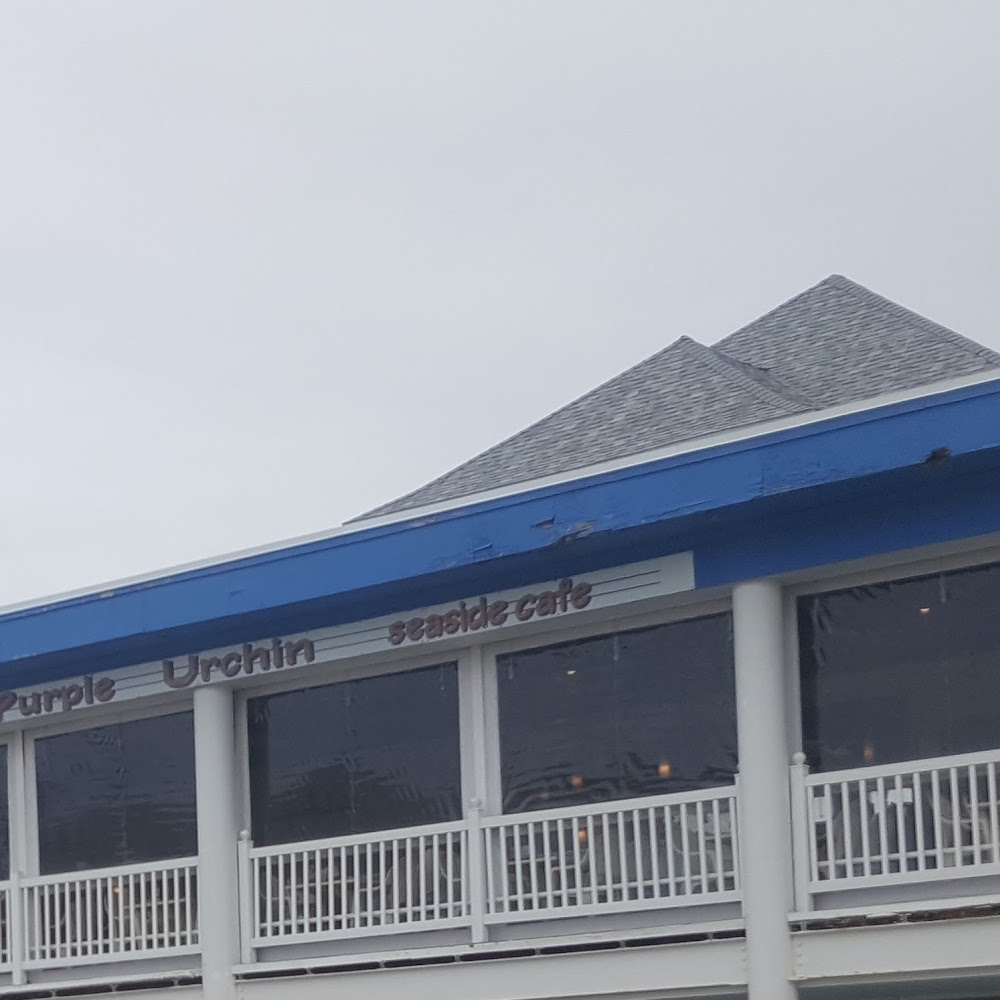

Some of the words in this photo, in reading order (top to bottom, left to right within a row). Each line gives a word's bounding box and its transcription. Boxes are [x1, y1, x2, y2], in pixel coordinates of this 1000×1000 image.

[162, 637, 315, 688] Urchin
[387, 596, 509, 646] seaside
[515, 577, 593, 621] cafe
